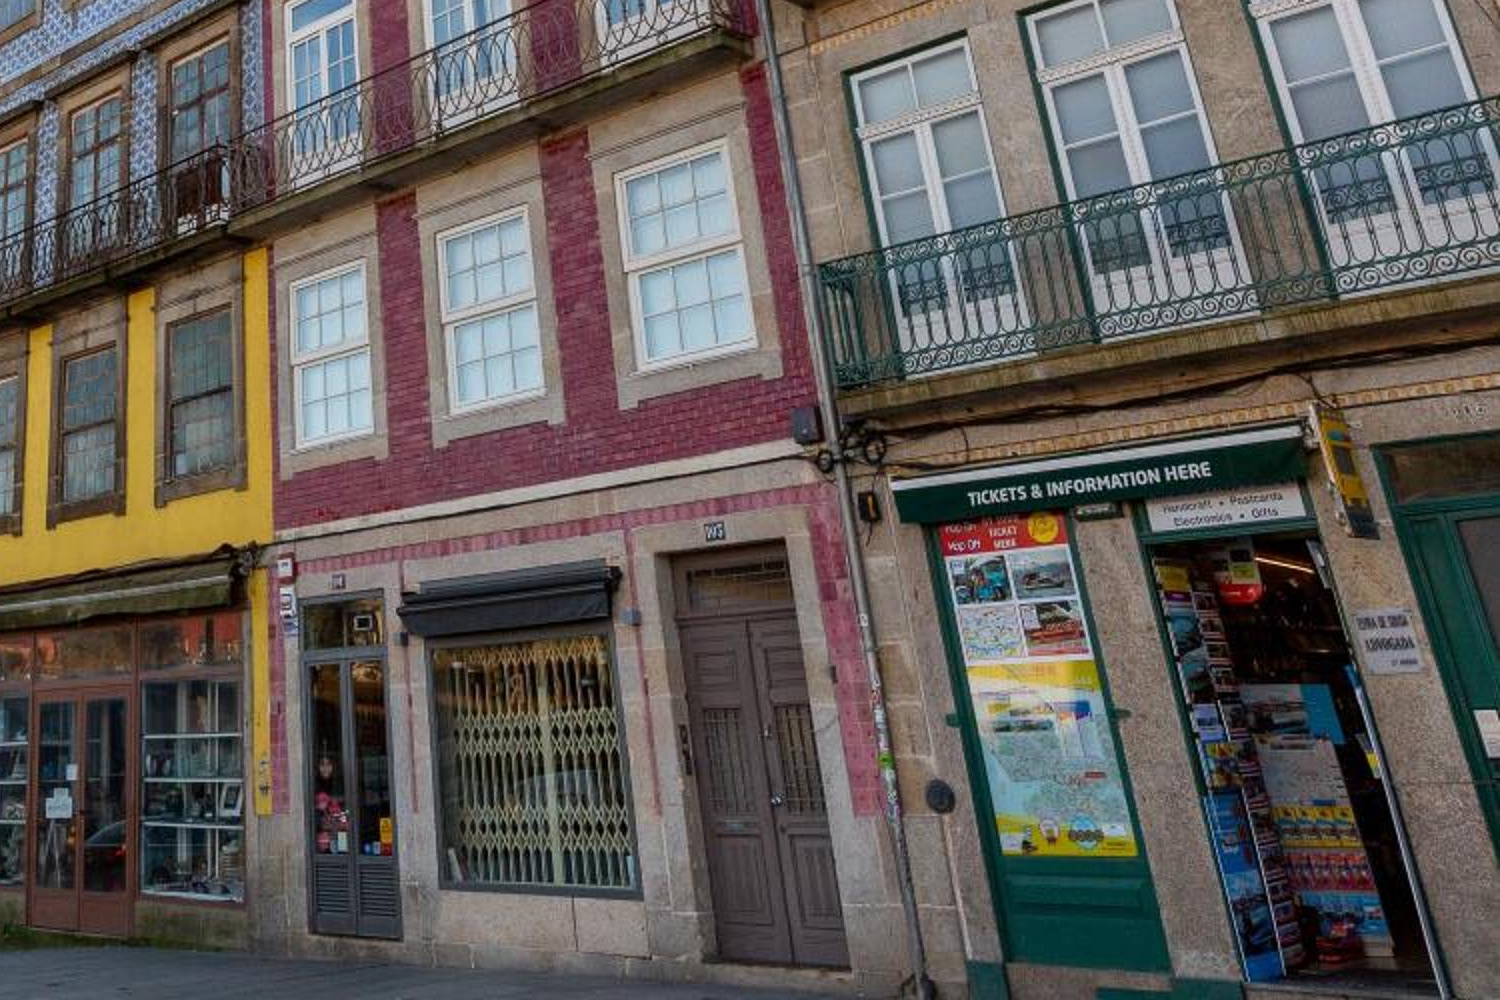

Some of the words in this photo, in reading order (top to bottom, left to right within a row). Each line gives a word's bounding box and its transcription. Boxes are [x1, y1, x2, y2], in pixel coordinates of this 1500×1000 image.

[968, 485, 1027, 507] TICKETS
[1031, 484, 1043, 499] &
[1047, 469, 1161, 497] INFORMATION
[1165, 461, 1212, 482] HERE
[1173, 513, 1233, 527] Electronics
[1251, 507, 1279, 519] Gifts
